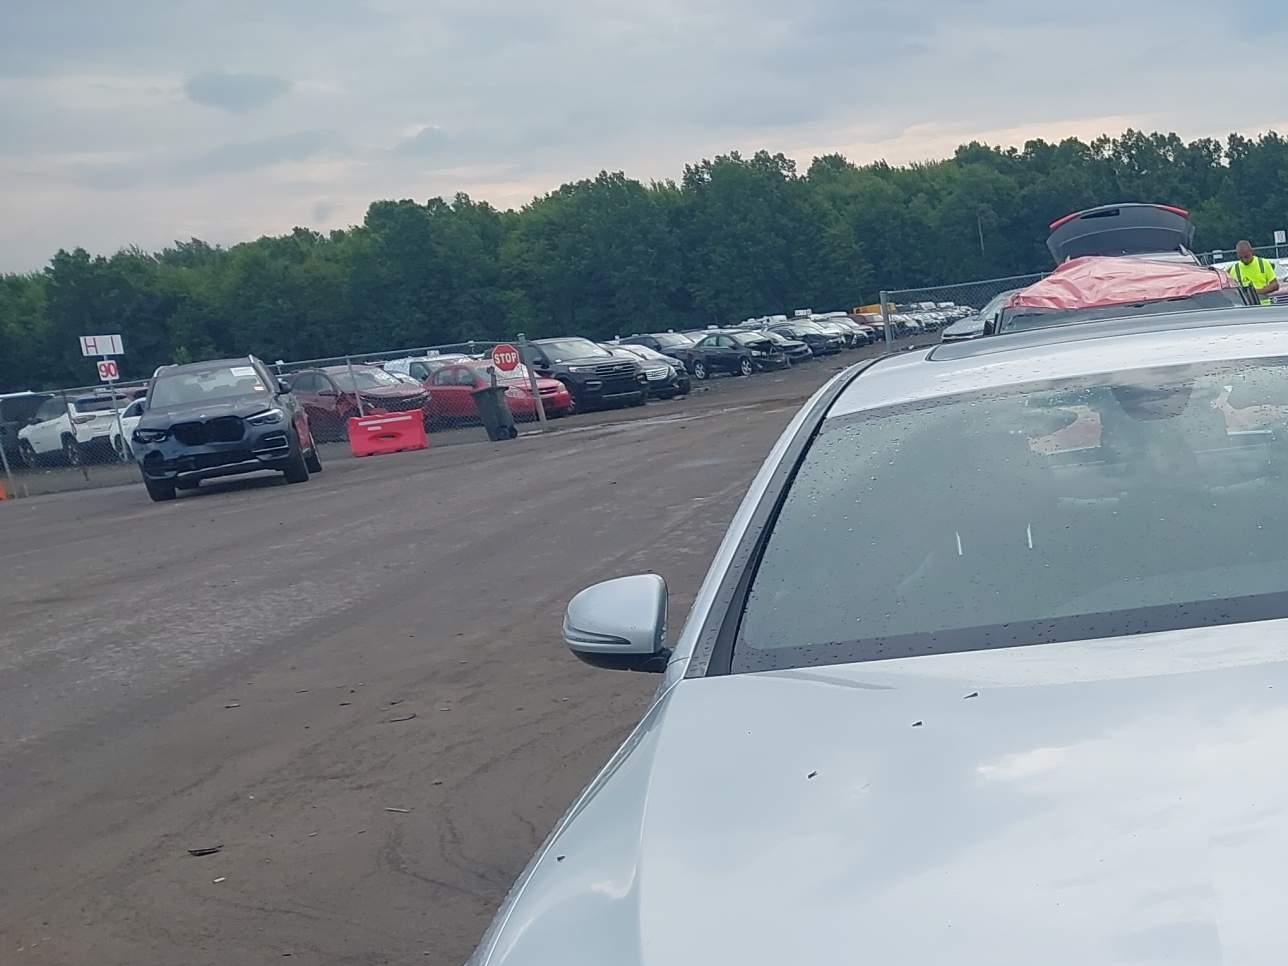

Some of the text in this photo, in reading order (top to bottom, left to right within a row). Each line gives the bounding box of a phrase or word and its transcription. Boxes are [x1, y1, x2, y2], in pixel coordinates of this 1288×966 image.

[84, 337, 99, 354] H
[494, 352, 517, 365] STOP
[99, 362, 117, 378] 90
